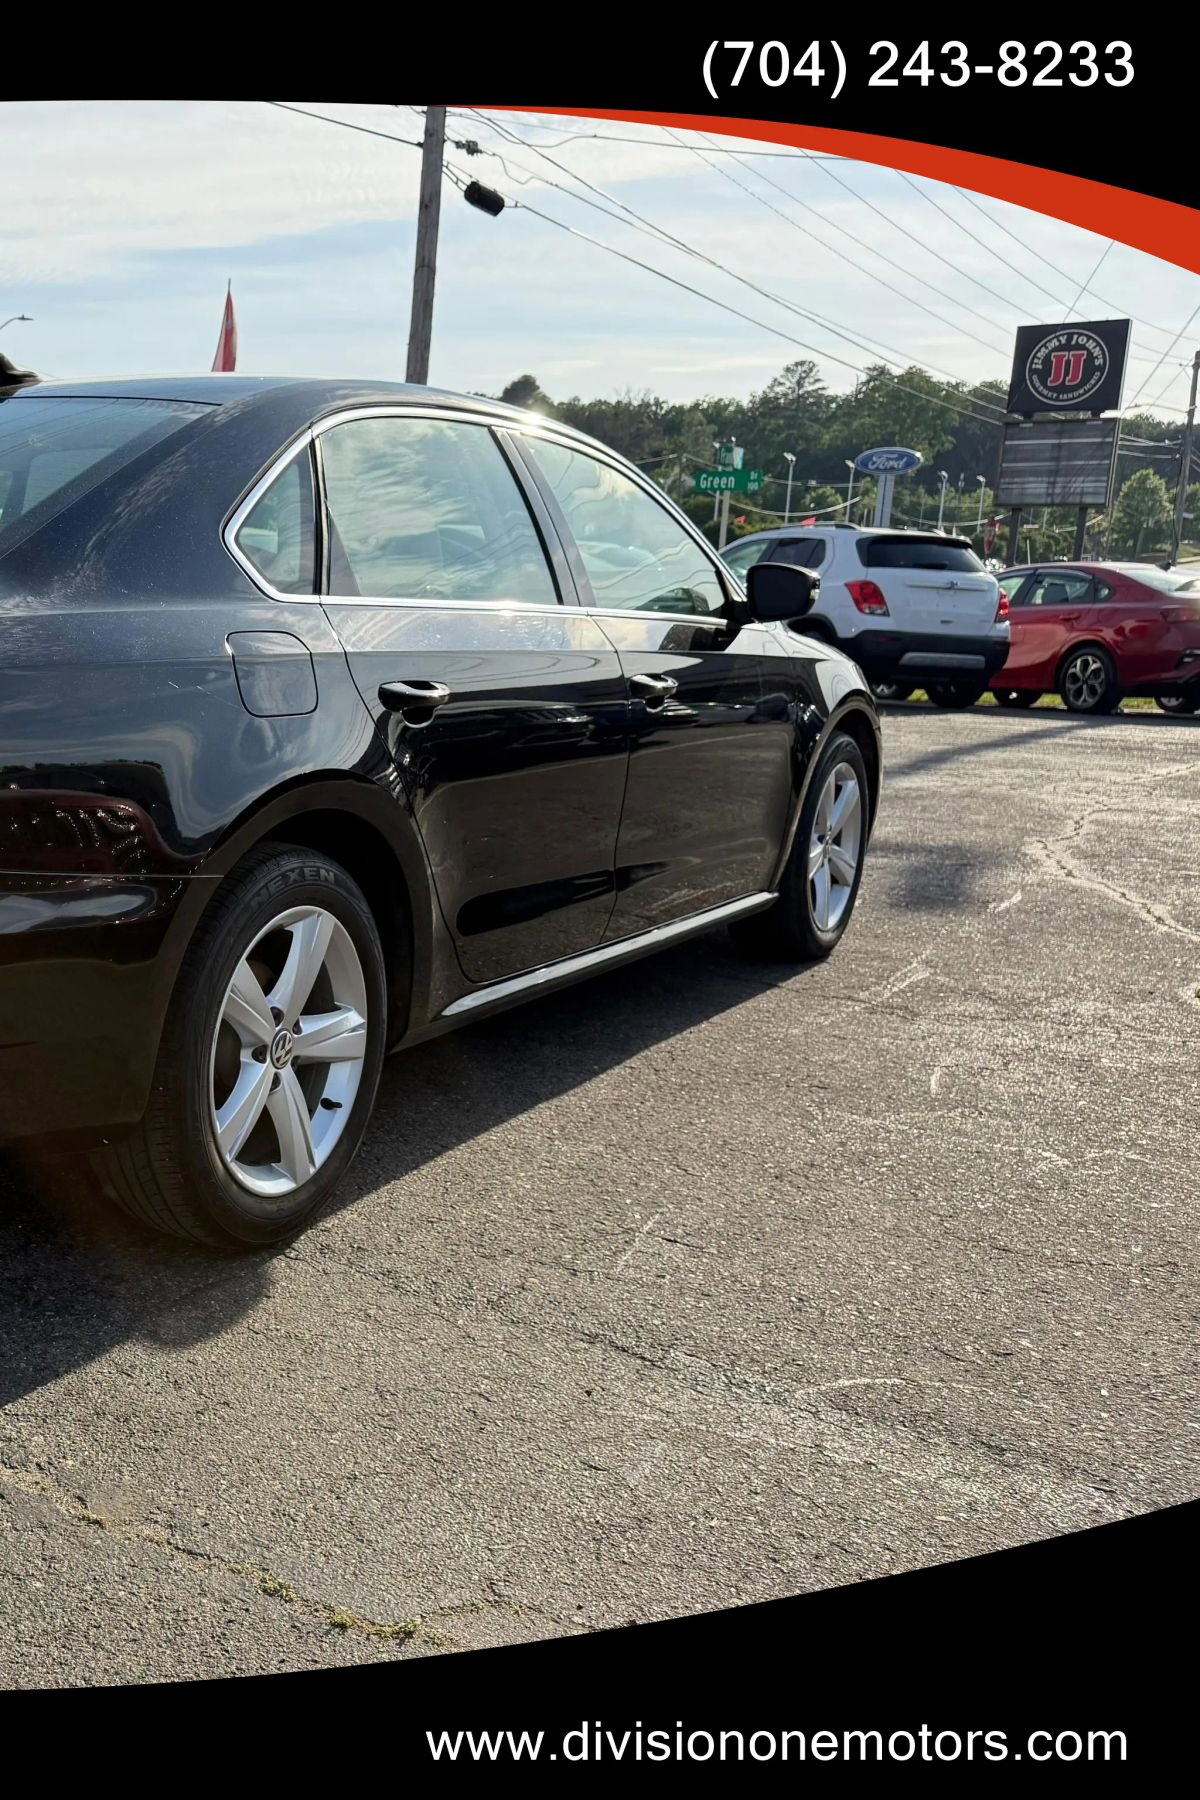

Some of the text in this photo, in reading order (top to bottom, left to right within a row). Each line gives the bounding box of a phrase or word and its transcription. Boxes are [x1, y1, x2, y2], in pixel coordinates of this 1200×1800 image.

[1032, 334, 1104, 369] JIMMY JOHN'S
[1047, 350, 1088, 387] JJ
[867, 453, 908, 470] Ford
[700, 473, 735, 489] Green
[250, 867, 335, 908] NEXEN
